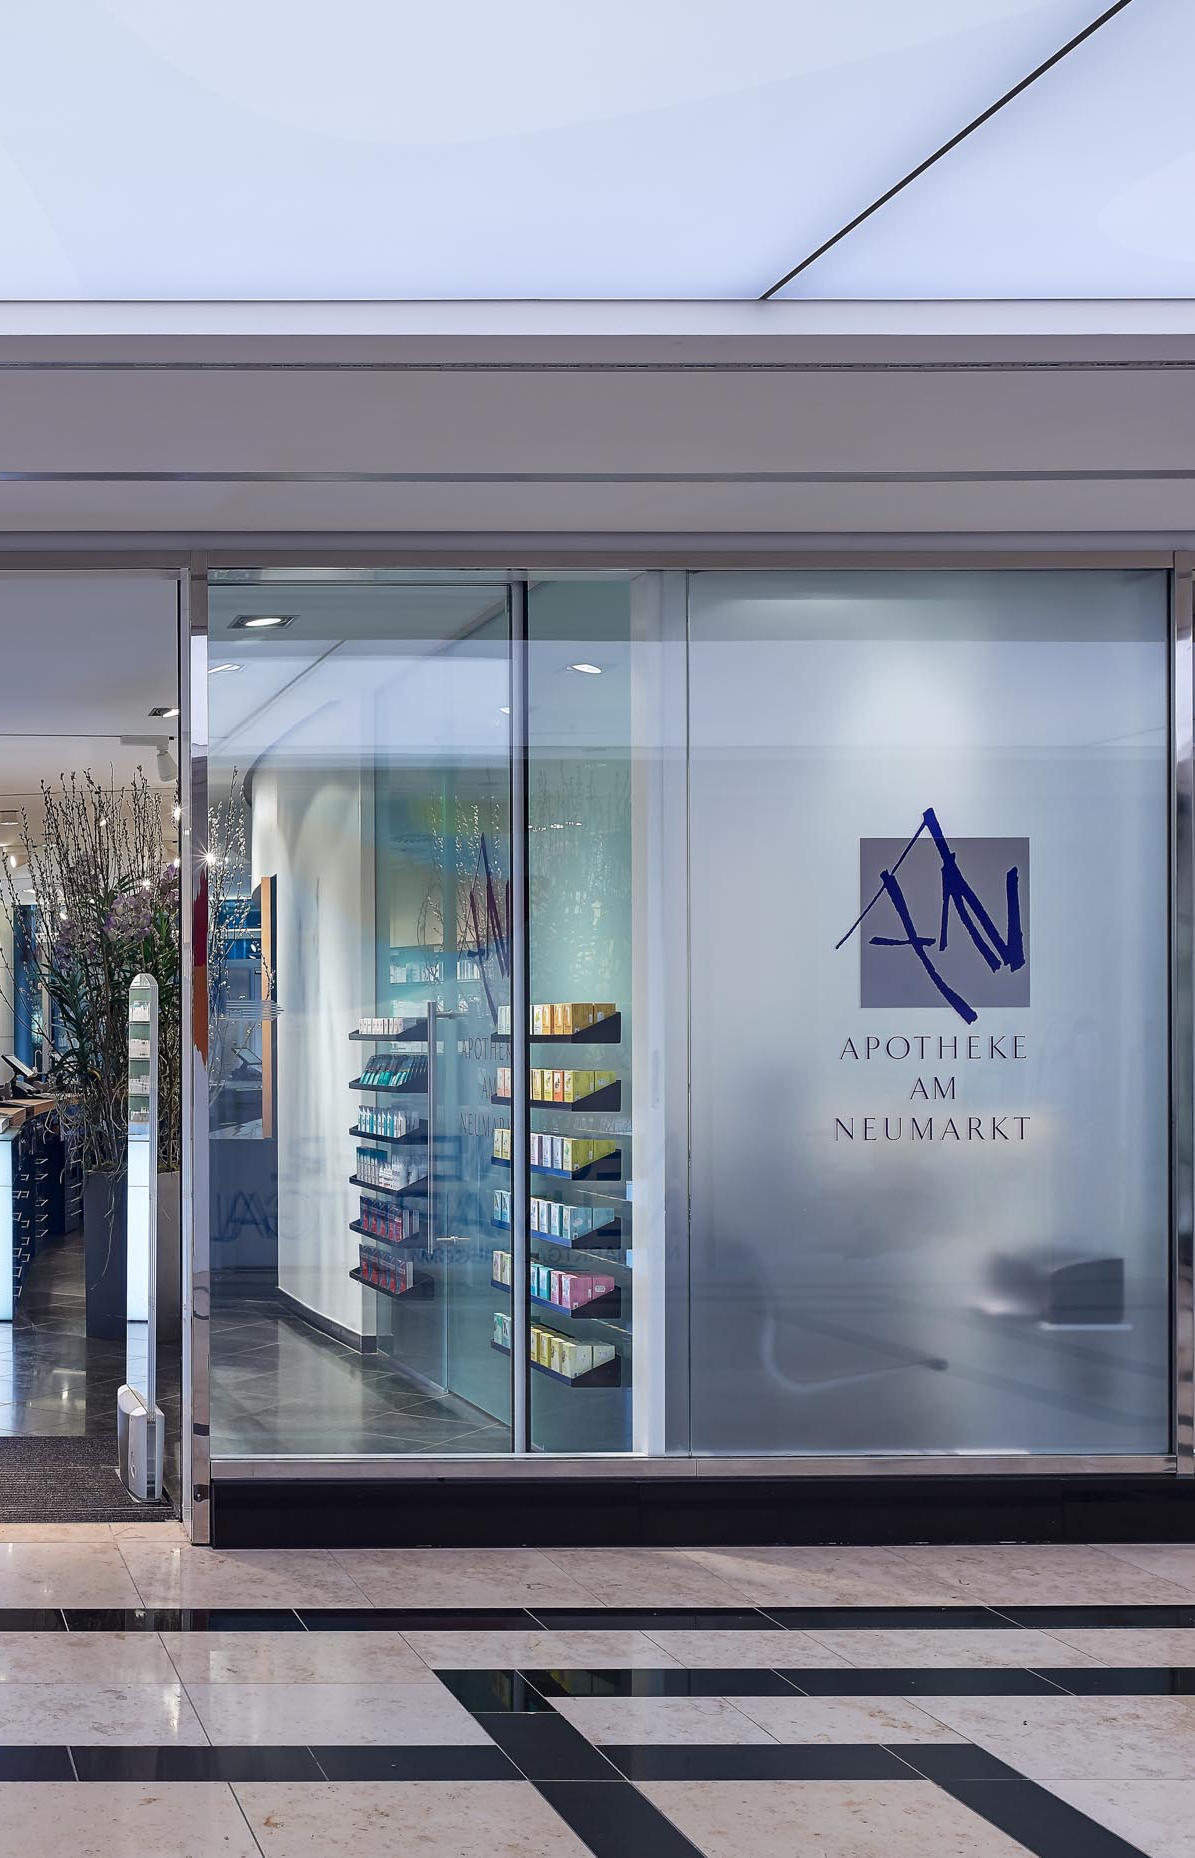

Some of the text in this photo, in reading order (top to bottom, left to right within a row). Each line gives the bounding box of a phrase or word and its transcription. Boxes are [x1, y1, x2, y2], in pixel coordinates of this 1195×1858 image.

[840, 1035, 1027, 1060] APOTHEKE
[910, 1076, 956, 1100] AM
[833, 1116, 1031, 1141] NEUMARKT
